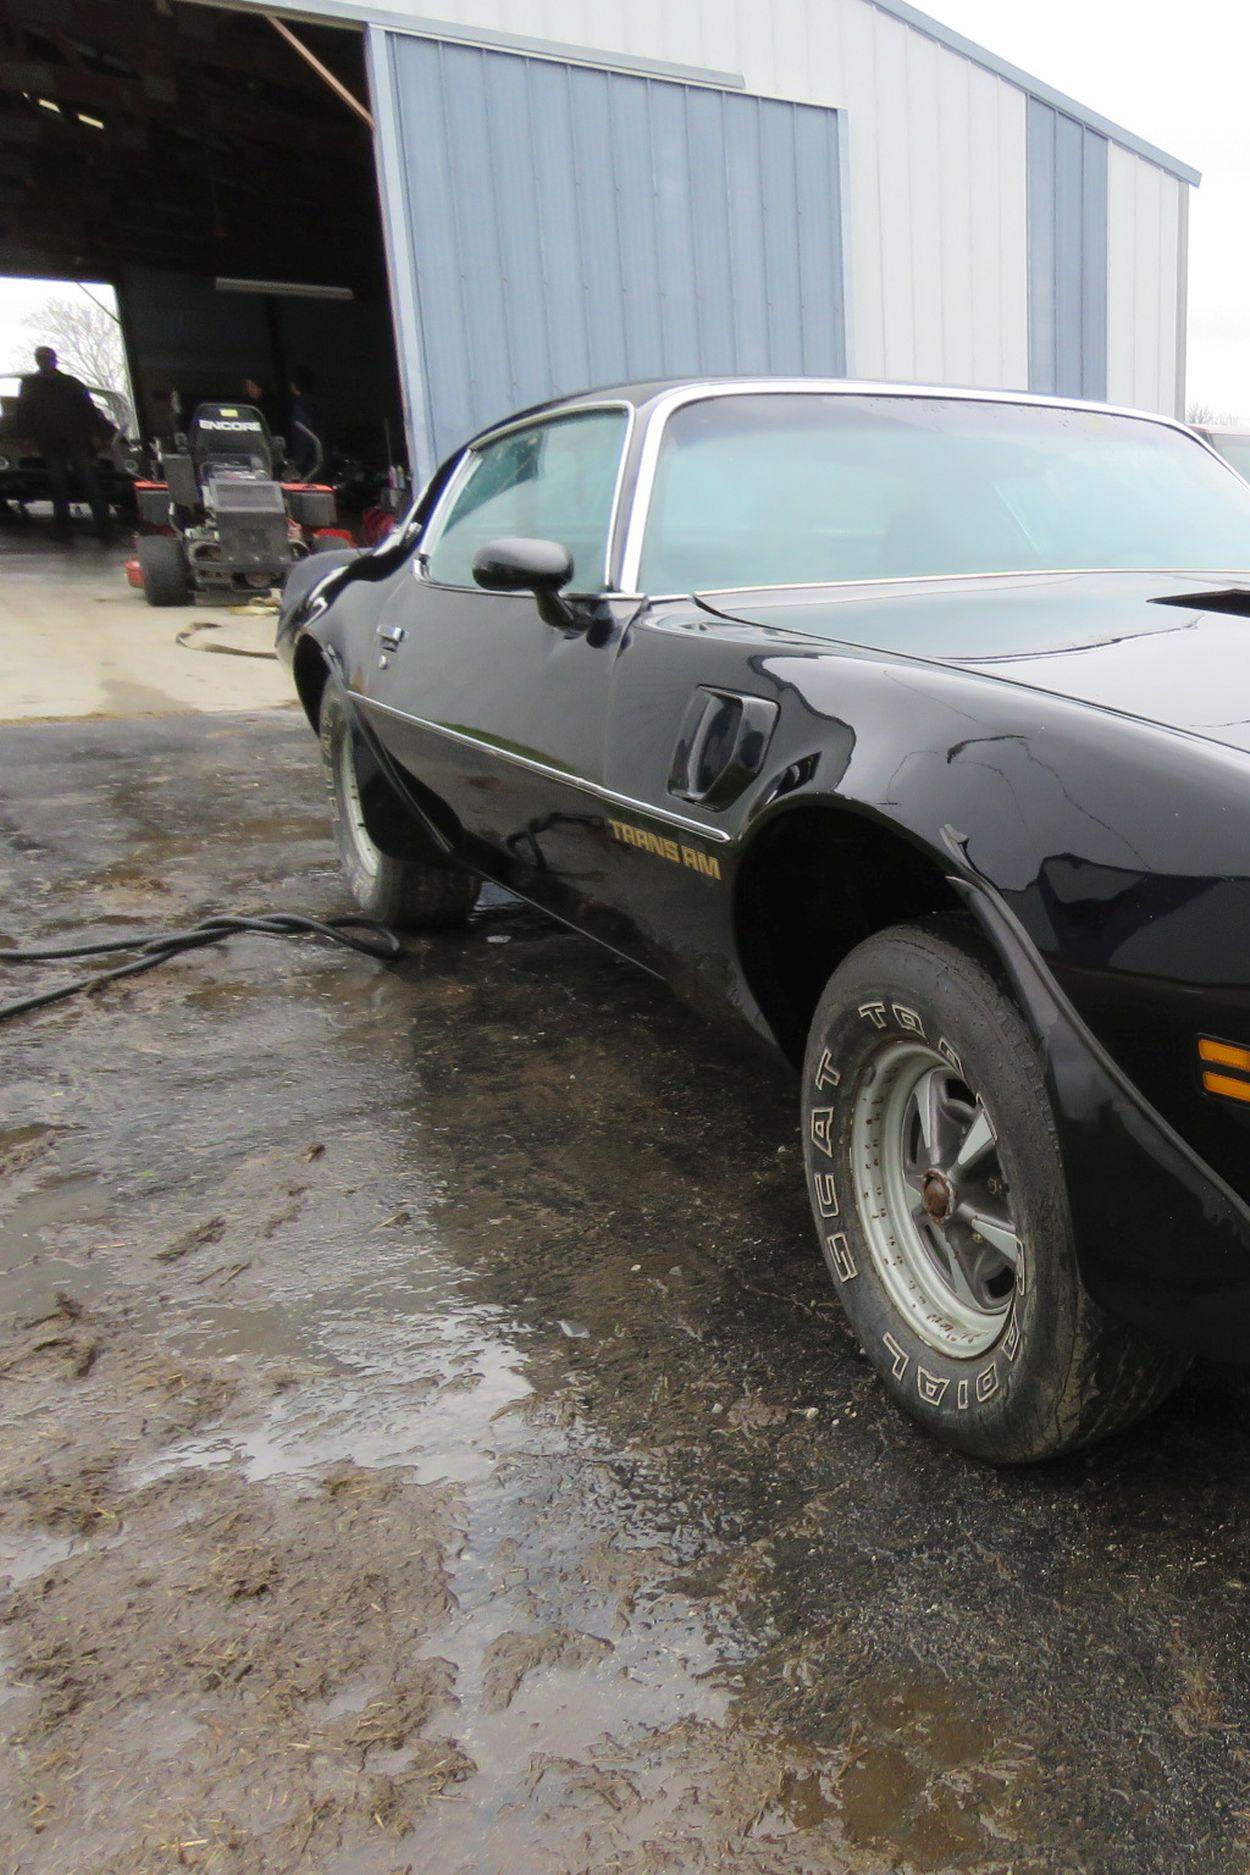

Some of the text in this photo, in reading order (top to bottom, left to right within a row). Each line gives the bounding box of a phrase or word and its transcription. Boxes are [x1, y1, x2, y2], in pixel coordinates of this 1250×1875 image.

[198, 419, 262, 432] ENCORE
[607, 818, 722, 880] TRANS AM
[811, 1048, 858, 1284] SCAT
